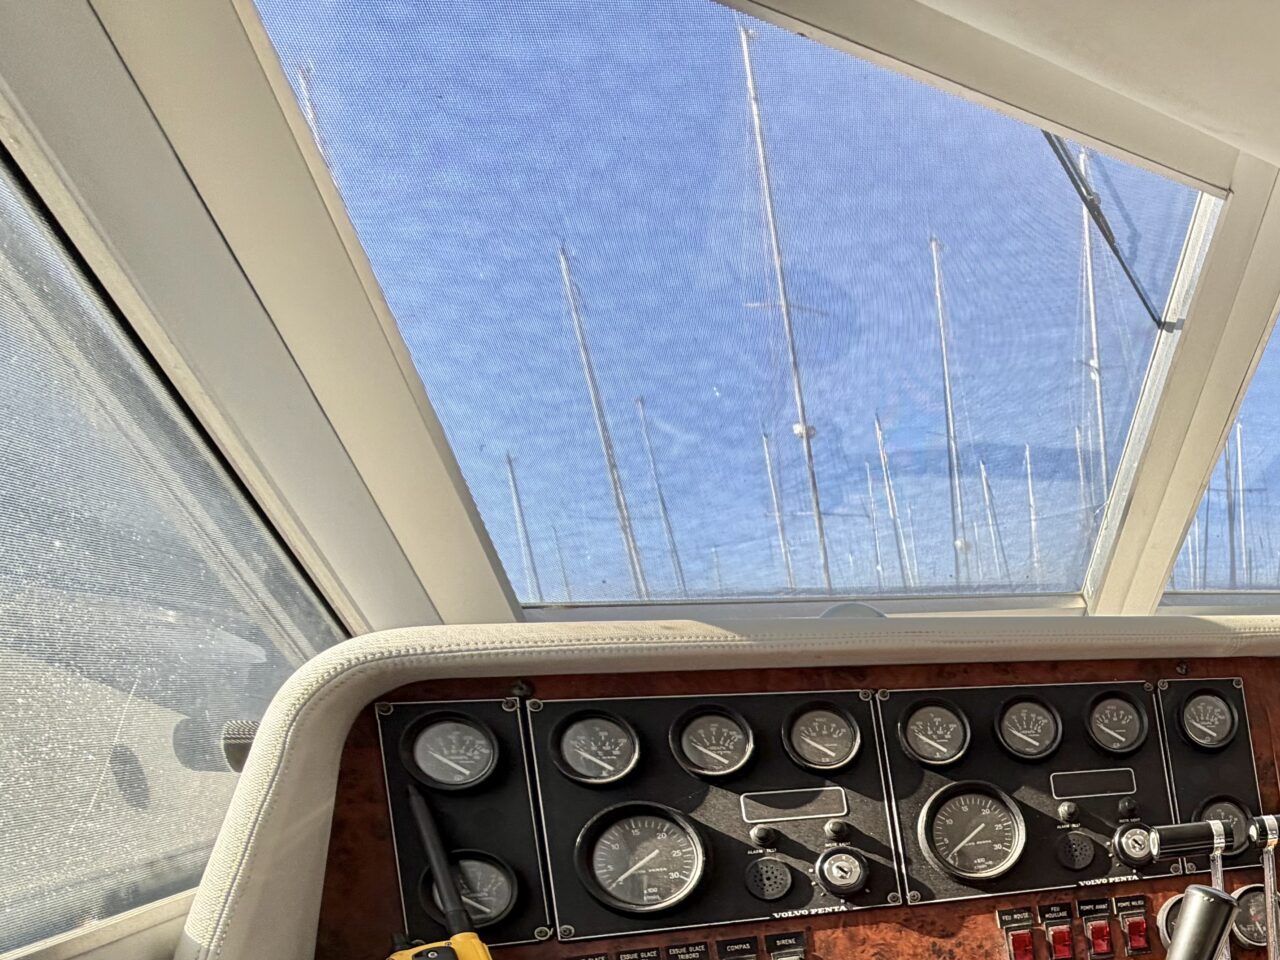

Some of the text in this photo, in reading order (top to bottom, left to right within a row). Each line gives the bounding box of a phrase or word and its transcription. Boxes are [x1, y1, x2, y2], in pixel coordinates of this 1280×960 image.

[1079, 875, 1139, 886] VOLVO PENTA
[773, 906, 848, 919] VOLVO PENTA
[776, 938, 796, 946] SIRENE
[669, 947, 687, 955] ESSUIE
[726, 943, 750, 952] COMPAS
[620, 950, 657, 960] ESSUIE GLACE
[678, 952, 700, 960] TRIBORD
